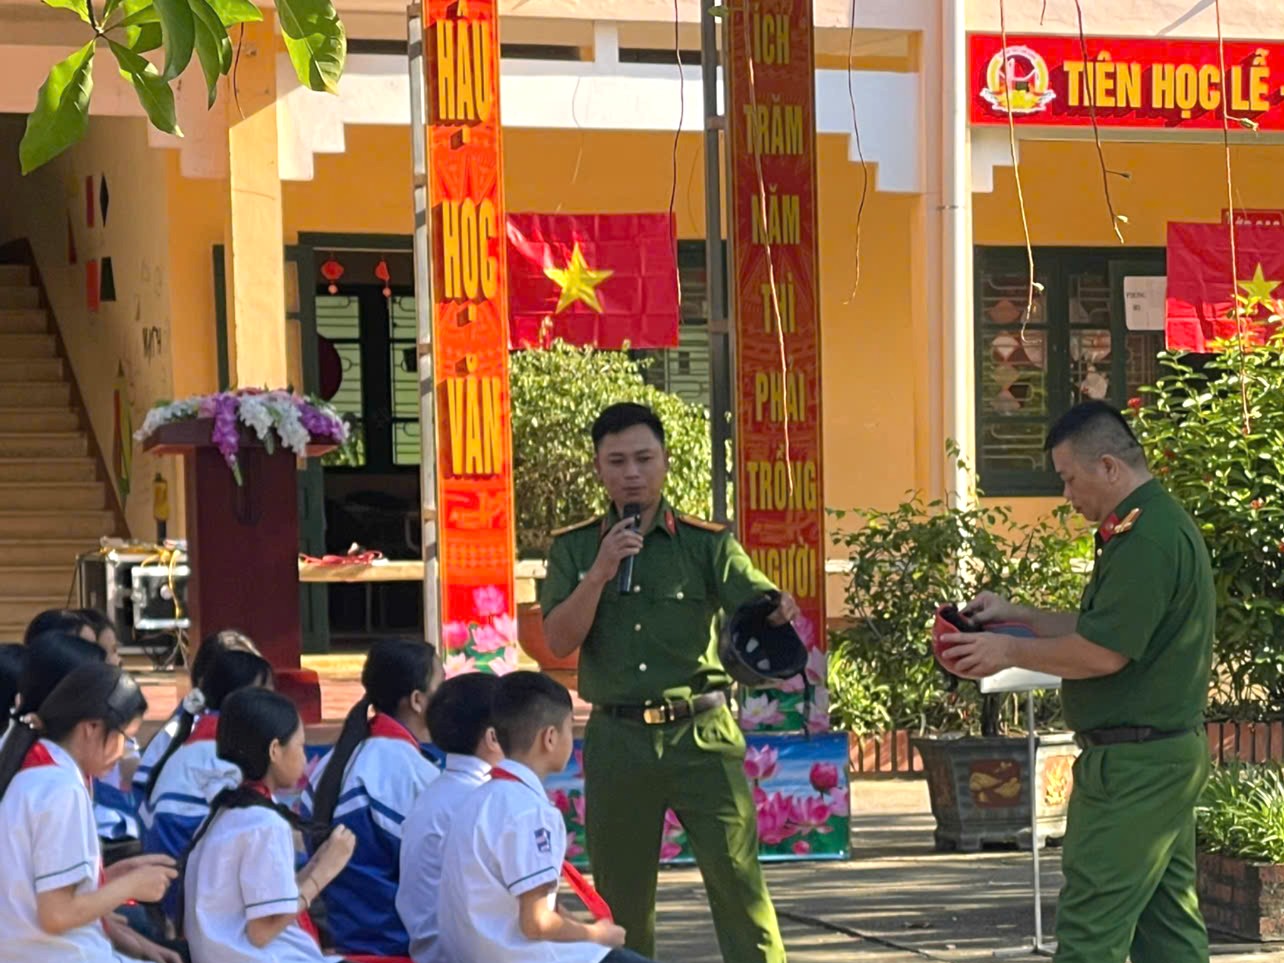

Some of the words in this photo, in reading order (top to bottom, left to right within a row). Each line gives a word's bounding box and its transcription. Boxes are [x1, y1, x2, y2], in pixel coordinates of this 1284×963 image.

[436, 0, 492, 144] HẬU
[1063, 50, 1141, 109] TIÊN
[1152, 63, 1221, 118] HỌC
[1231, 48, 1270, 112] LỄ
[743, 93, 803, 155] TRĂM
[442, 197, 498, 321] HỌC
[751, 183, 800, 245] NĂM
[447, 352, 502, 475] VĂN
